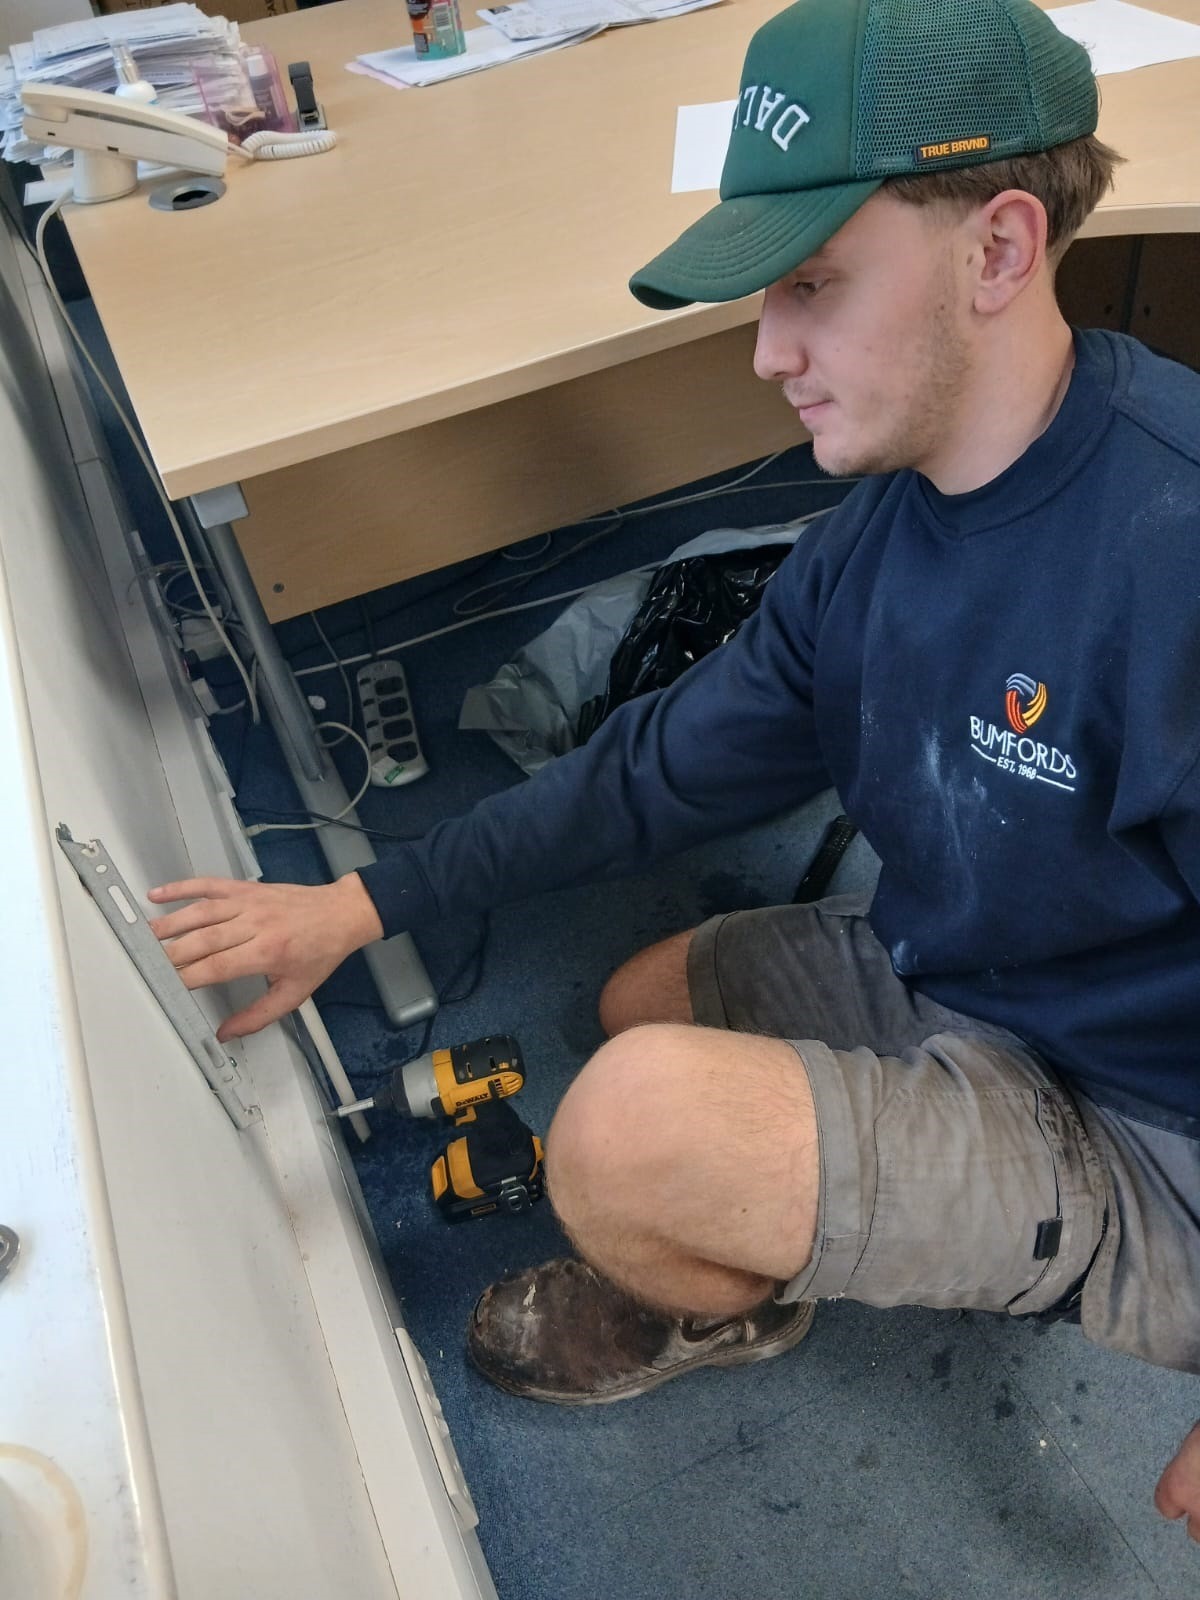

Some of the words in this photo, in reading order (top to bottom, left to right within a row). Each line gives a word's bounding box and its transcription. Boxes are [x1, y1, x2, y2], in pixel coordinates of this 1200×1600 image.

[735, 85, 810, 151] DAL
[920, 144, 950, 160] TRUE
[951, 137, 988, 154] BRVND
[970, 715, 1077, 778] BUMFORDS
